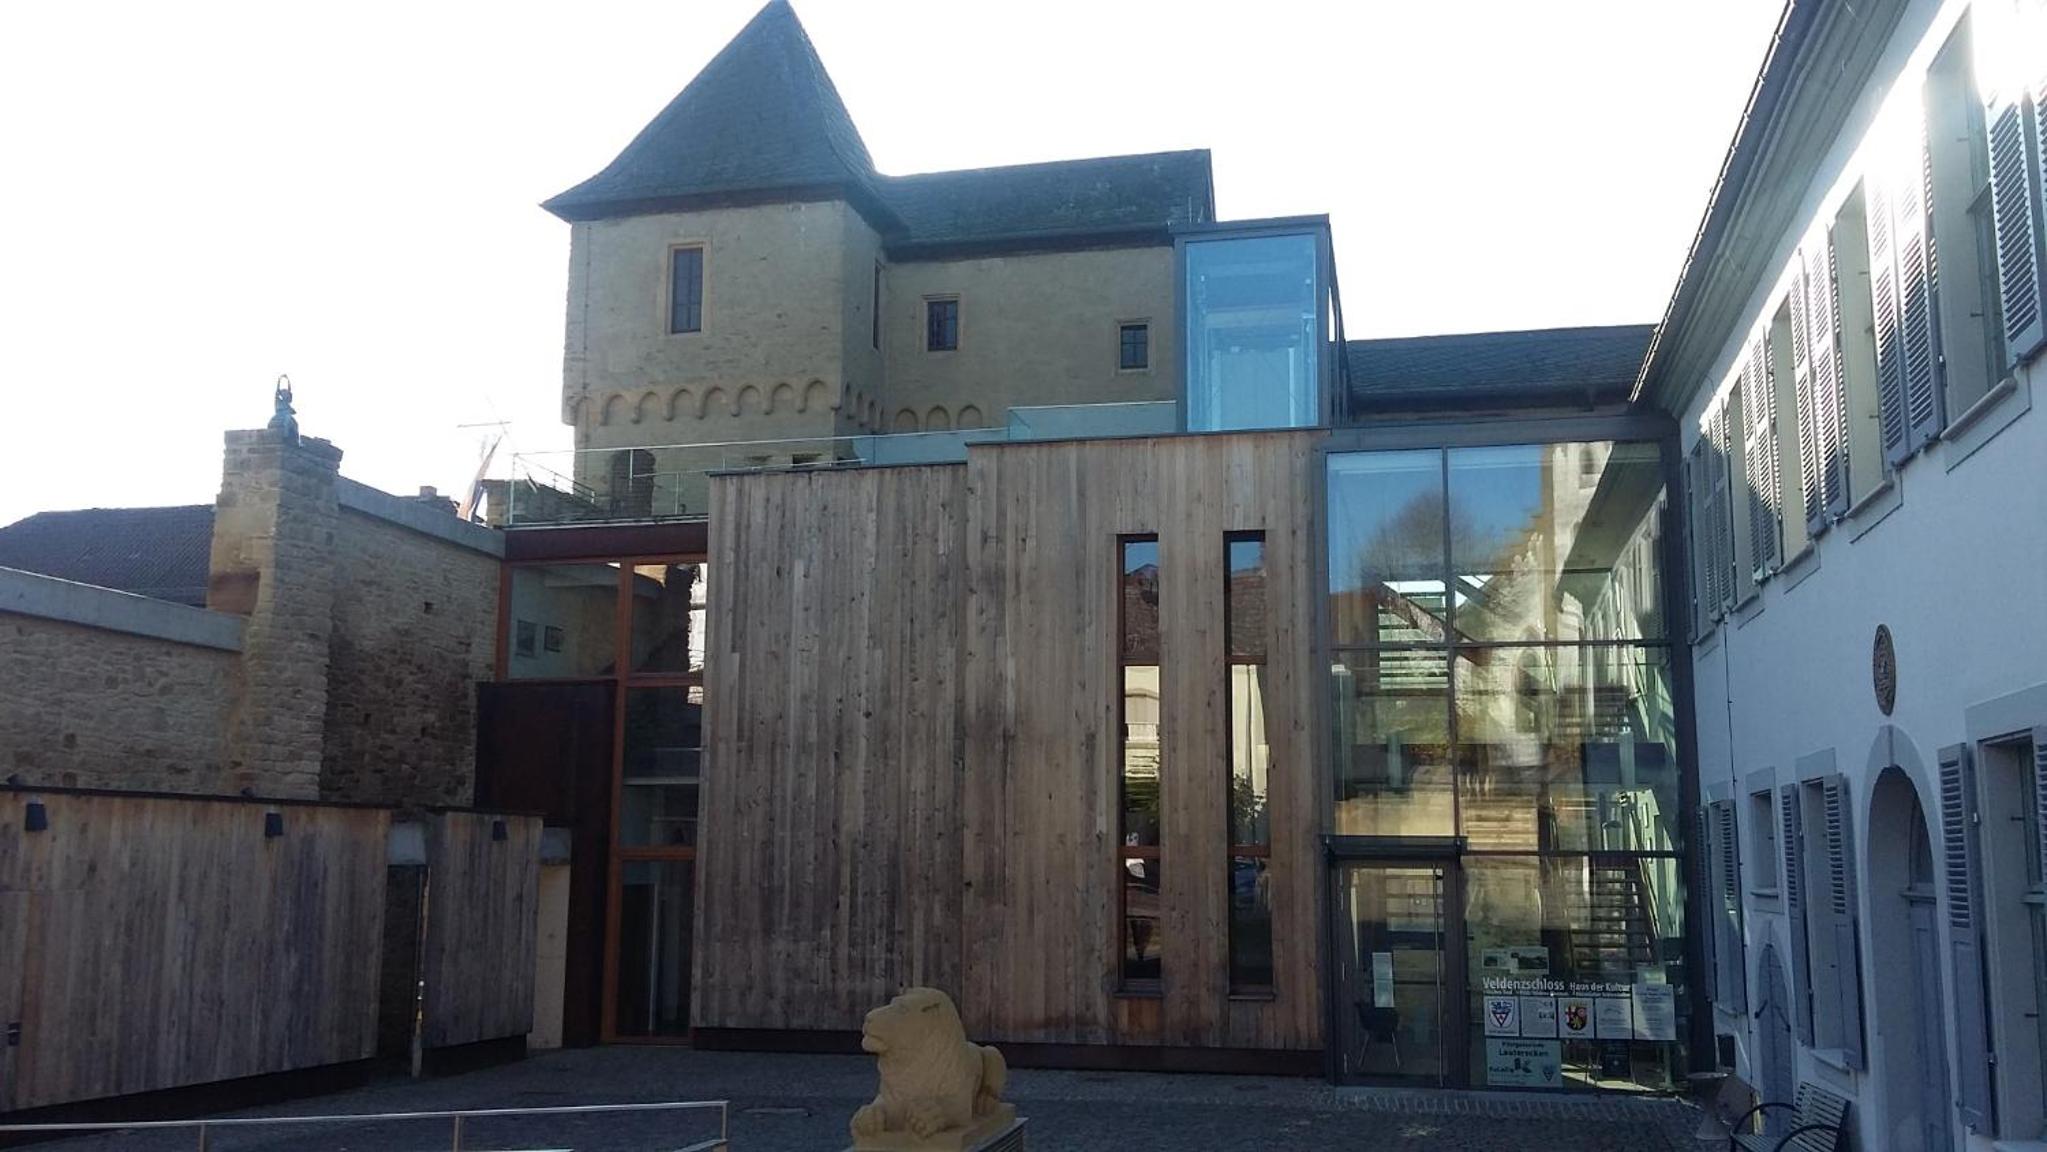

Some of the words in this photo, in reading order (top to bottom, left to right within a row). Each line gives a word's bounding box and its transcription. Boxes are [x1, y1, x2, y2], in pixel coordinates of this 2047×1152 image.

[1483, 976, 1565, 991] Veldenzschloss
[1570, 982, 1590, 992] Haus
[1591, 982, 1604, 992] der
[1605, 982, 1631, 992] Kultur
